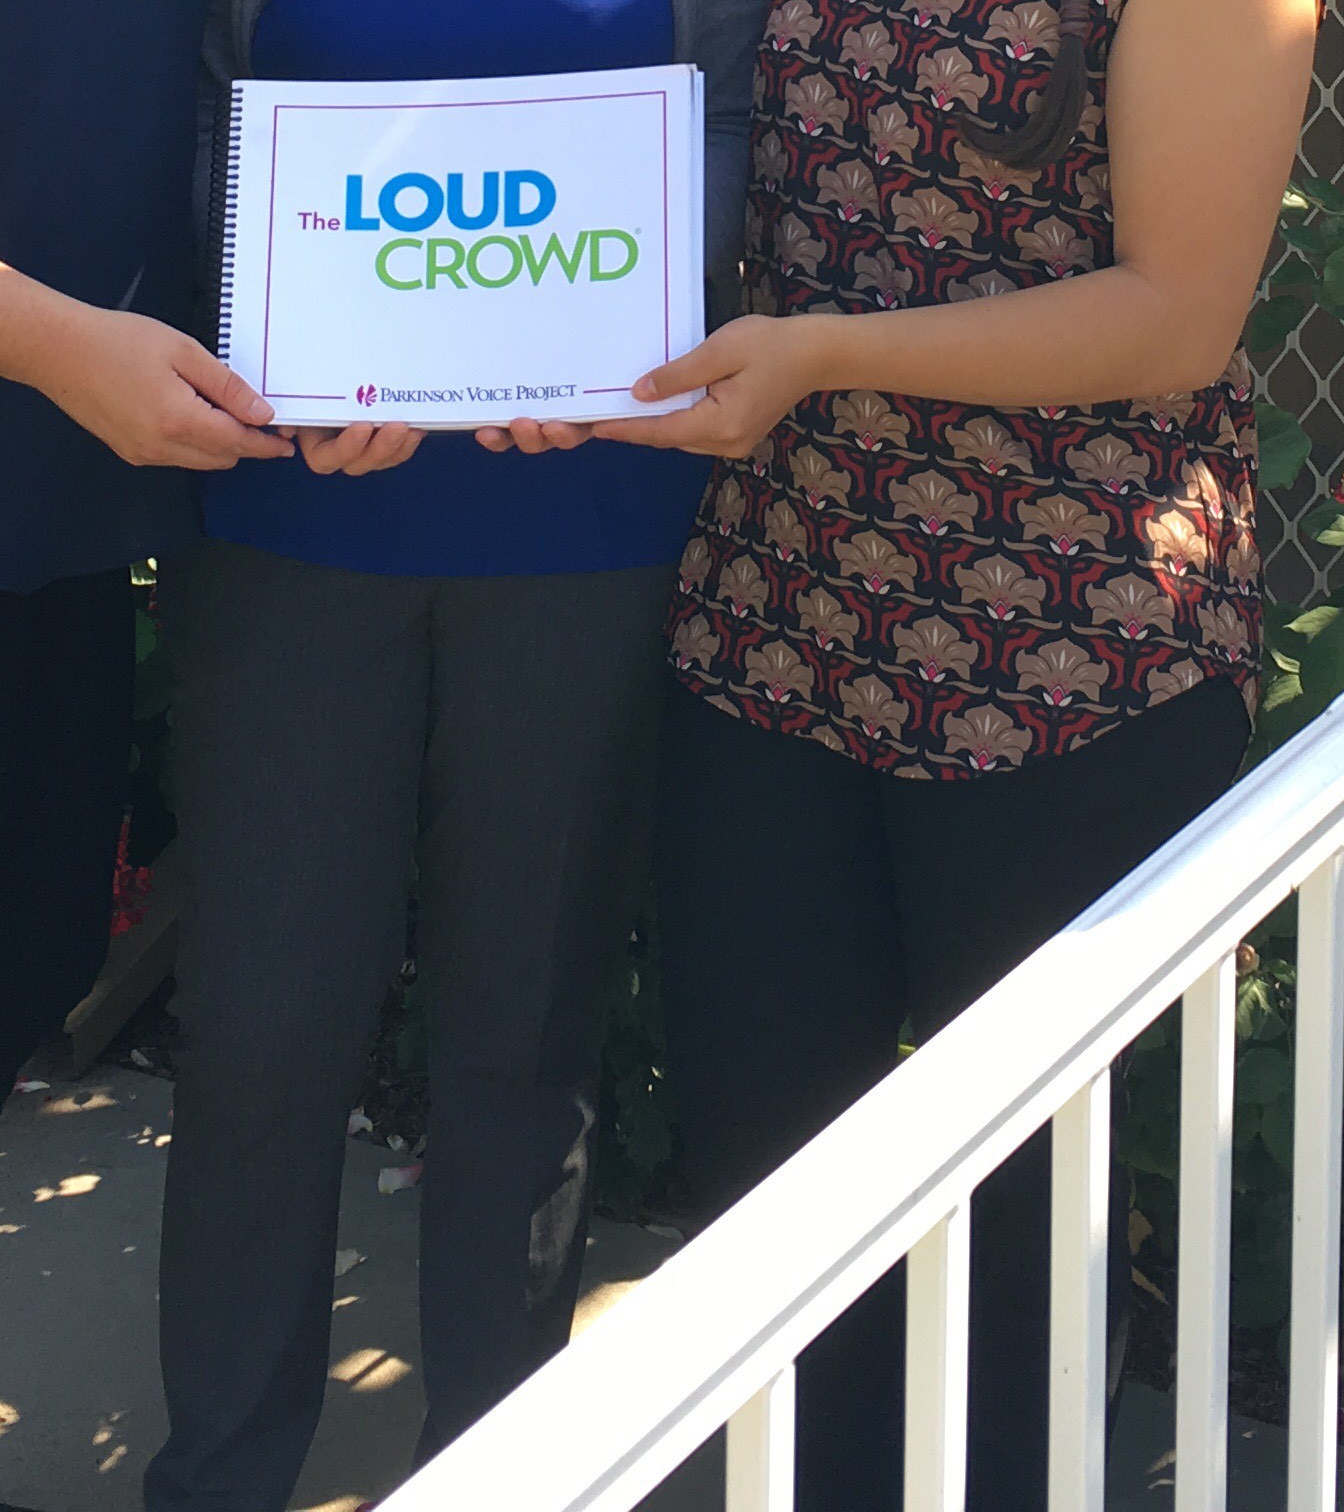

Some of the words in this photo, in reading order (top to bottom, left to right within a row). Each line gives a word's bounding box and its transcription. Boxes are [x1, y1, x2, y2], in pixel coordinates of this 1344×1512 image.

[297, 211, 341, 231] The
[344, 169, 557, 233] LOUD
[380, 386, 464, 403] PARKINSON
[466, 386, 513, 402] VOICE
[515, 383, 577, 401] PROJECT
